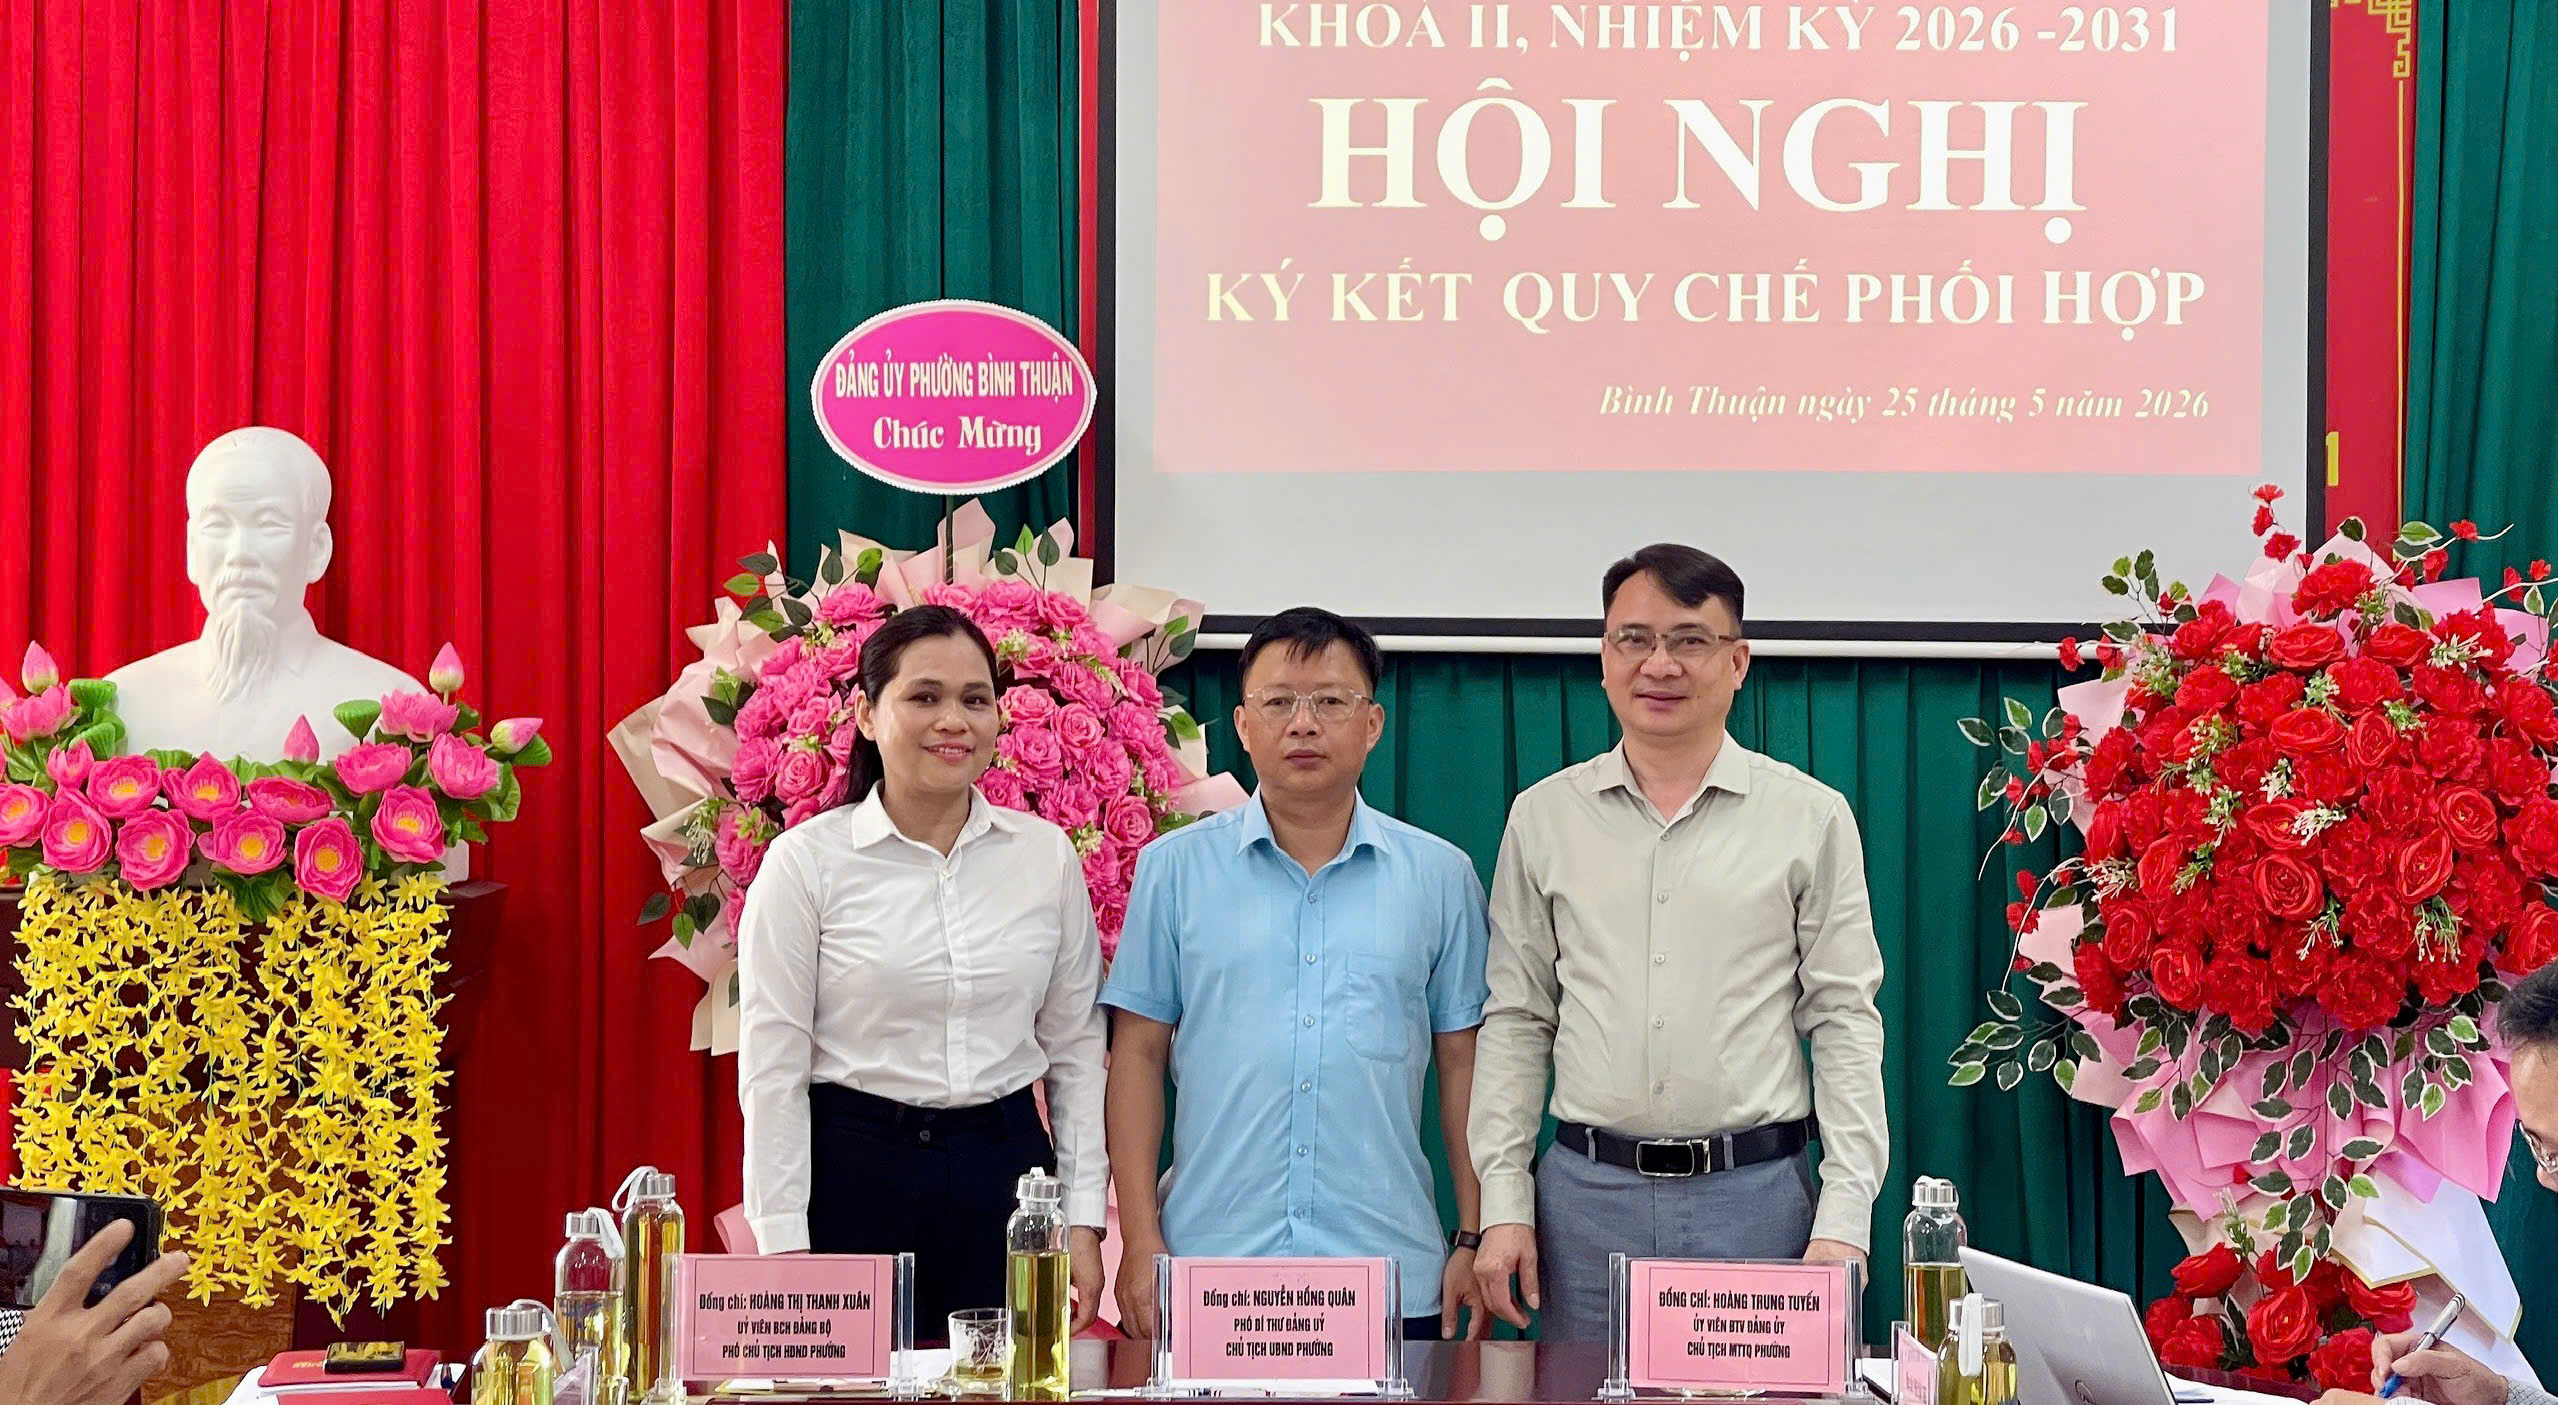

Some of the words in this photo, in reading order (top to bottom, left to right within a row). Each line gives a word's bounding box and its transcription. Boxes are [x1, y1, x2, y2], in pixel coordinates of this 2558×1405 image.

[1470, 4, 1529, 54] II,
[1895, 5, 2019, 51] 2026
[2037, 6, 2176, 53] -2031
[1307, 77, 1617, 242] HỘI
[1662, 98, 2089, 244] NGHỊ
[1207, 257, 1305, 321] KÝ
[1331, 257, 1473, 322] KẾT
[1503, 272, 1655, 335] QUY
[1674, 258, 1820, 323] CHẾ
[1846, 259, 2014, 324] PHỐI
[2042, 267, 2205, 341] HỢP
[835, 348, 879, 398] ĐẢNG
[883, 348, 905, 398] ỦY
[909, 352, 974, 398] PHƯỜNG
[977, 352, 1016, 397] BÌNH
[1019, 351, 1073, 404] THUẬN
[1600, 385, 1673, 415] Bình
[1689, 386, 1786, 423] Thuận
[1798, 386, 1872, 424] ngày
[1882, 387, 1919, 417] 25
[1928, 387, 2017, 423] tháng
[2028, 388, 2046, 417] 5
[2055, 390, 2123, 417] năm
[2135, 388, 2209, 418] 2026
[873, 416, 945, 449] Chúc
[957, 415, 1042, 456] Mừng
[787, 1293, 804, 1314] THỊ
[805, 1293, 840, 1310] THANH
[841, 1290, 871, 1311] XUÂN
[1327, 1286, 1356, 1309] QUÂN
[1689, 1288, 1711, 1309] CHÍ:
[1713, 1289, 1748, 1310] HOÀNG
[1750, 1293, 1785, 1311] TRUNG
[750, 1318, 772, 1335] VIÊN
[773, 1320, 792, 1335] BCH
[819, 1318, 832, 1339] BỘ
[1233, 1314, 1253, 1332] PHÓ
[1266, 1316, 1285, 1332] THƯ
[1706, 1316, 1727, 1333] VIÊN
[1728, 1319, 1746, 1334] BTV
[722, 1341, 740, 1359] PHÓ
[742, 1338, 760, 1359] CHỦ
[762, 1344, 782, 1362] TỊCH
[1225, 1335, 1245, 1357] CHỦ
[1246, 1341, 1267, 1360] TỊCH
[1269, 1341, 1294, 1357] UBND
[1687, 1335, 1705, 1357] CHỦ
[1707, 1342, 1727, 1360] TỊCH
